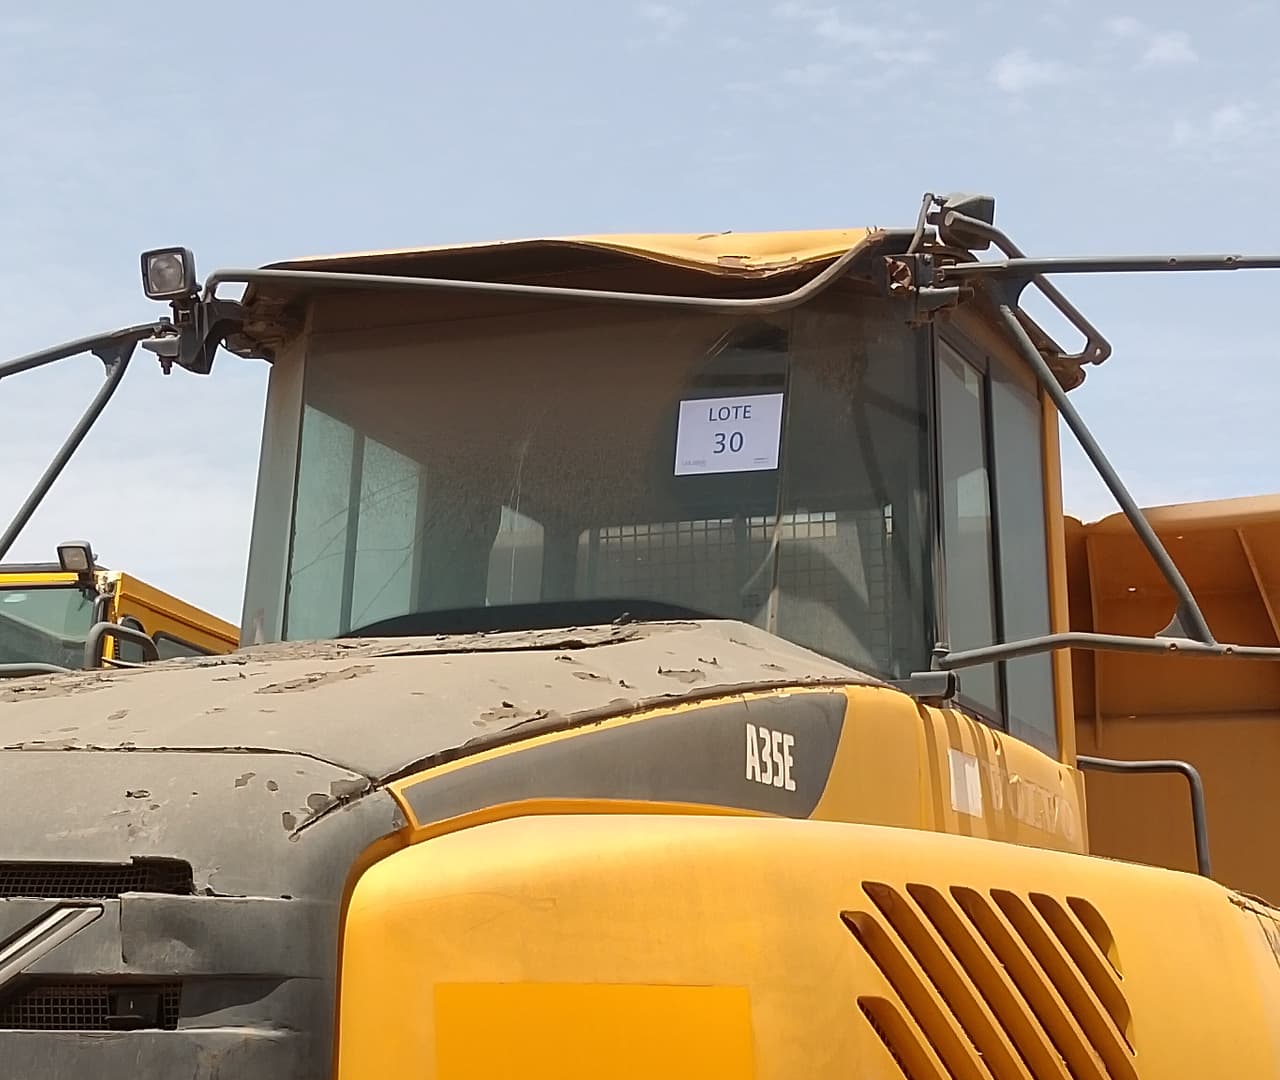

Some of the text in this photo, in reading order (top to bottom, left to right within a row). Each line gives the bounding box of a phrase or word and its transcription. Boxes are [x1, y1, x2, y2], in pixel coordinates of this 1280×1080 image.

[708, 405, 752, 421] LOTE
[713, 432, 744, 453] 30
[746, 723, 796, 791] A35E
